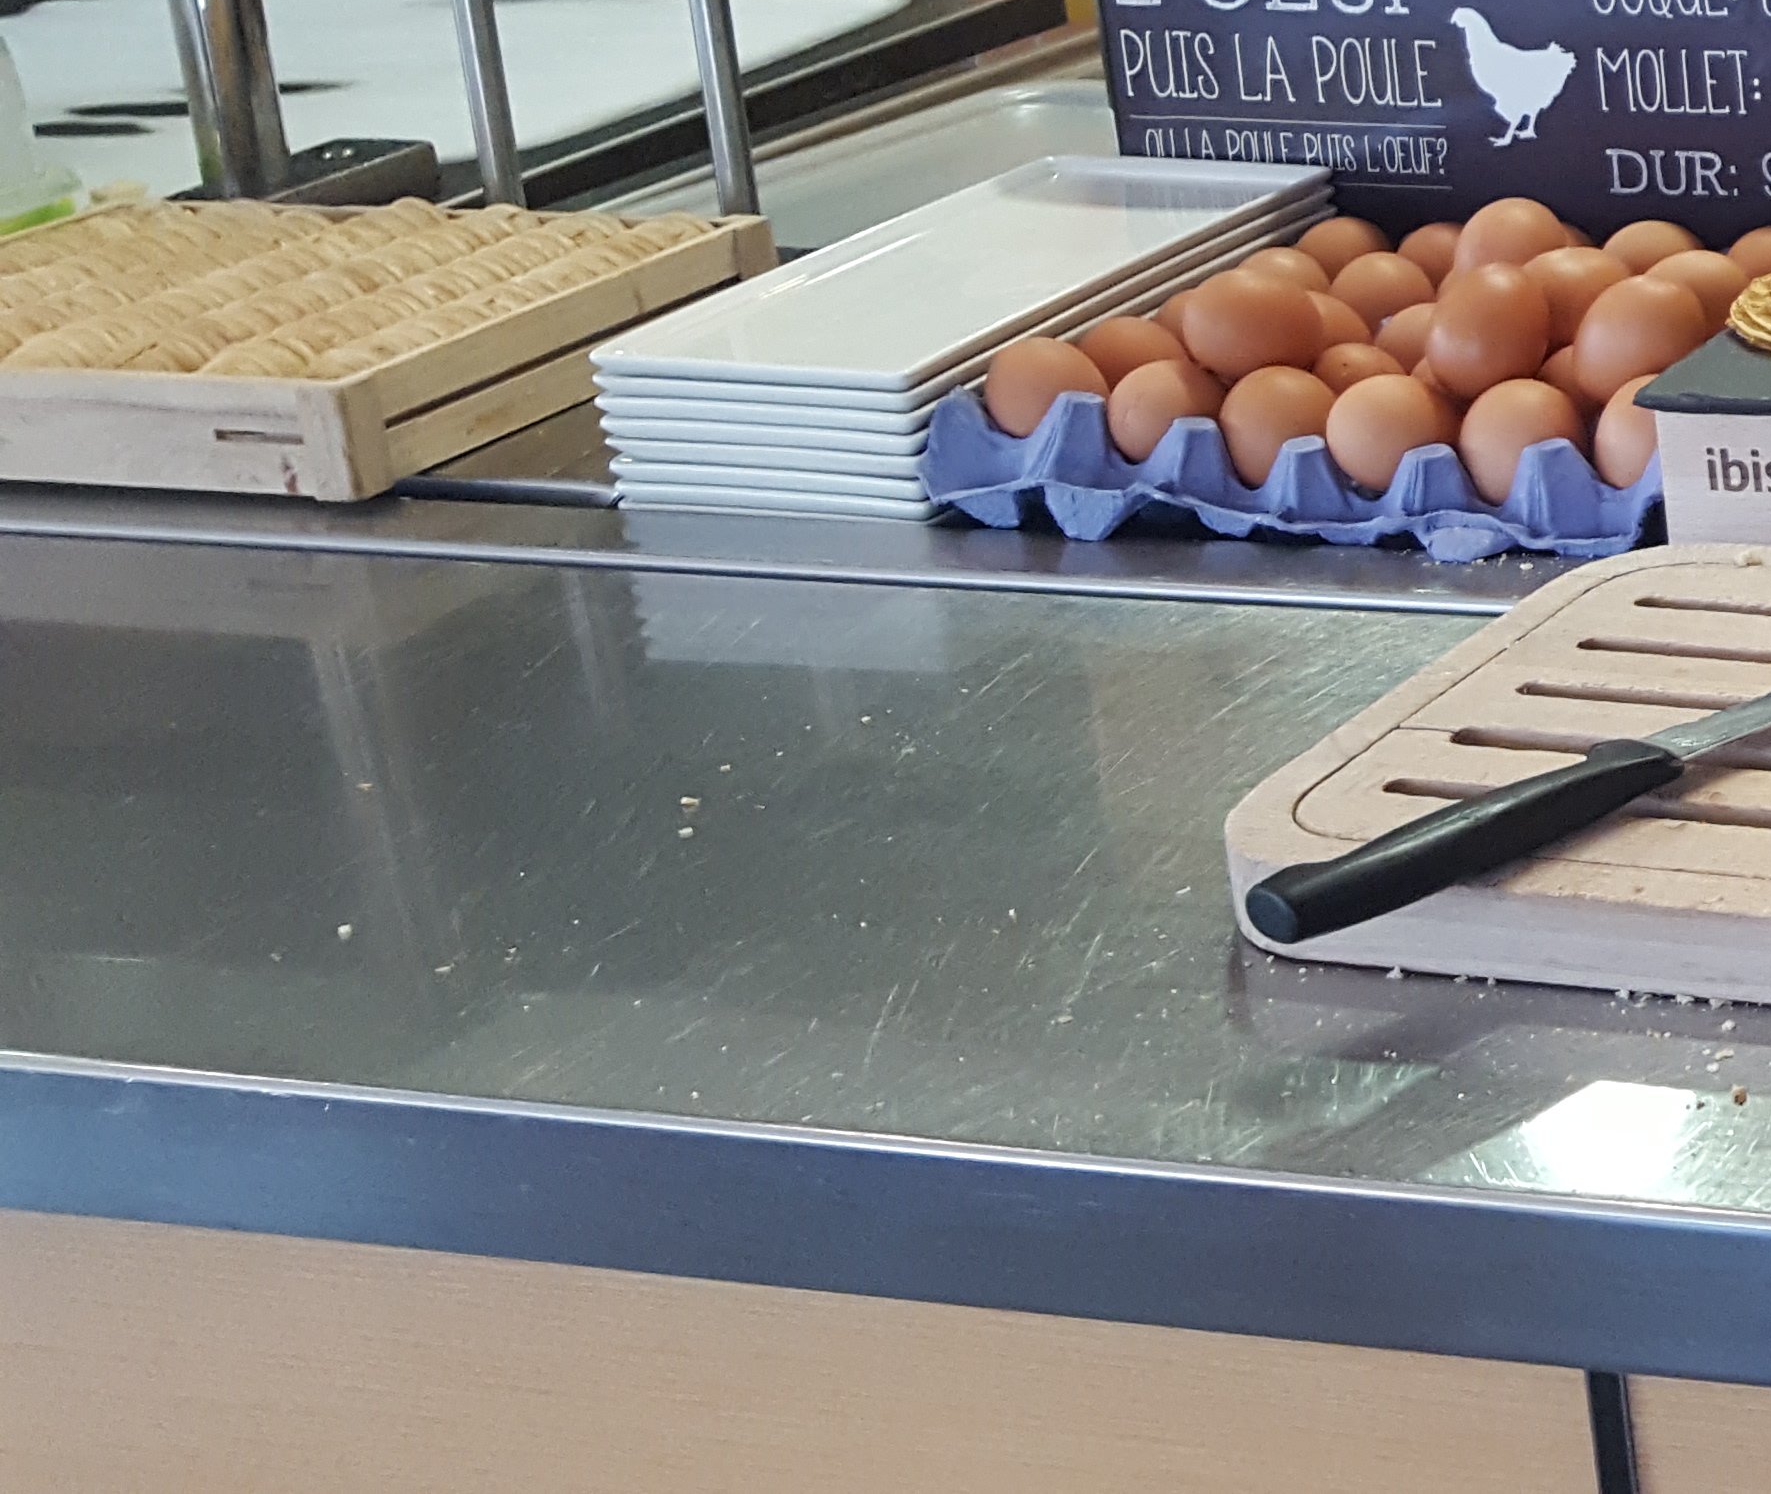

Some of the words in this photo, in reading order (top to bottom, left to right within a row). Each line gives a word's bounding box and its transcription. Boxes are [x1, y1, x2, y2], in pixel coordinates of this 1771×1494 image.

[1119, 28, 1219, 100] PUIS
[1234, 32, 1297, 104] LA
[1311, 35, 1443, 108] POULE
[1596, 47, 1762, 115] MOLLET:
[1302, 131, 1358, 172] PUIS
[1605, 147, 1739, 197] DUR:
